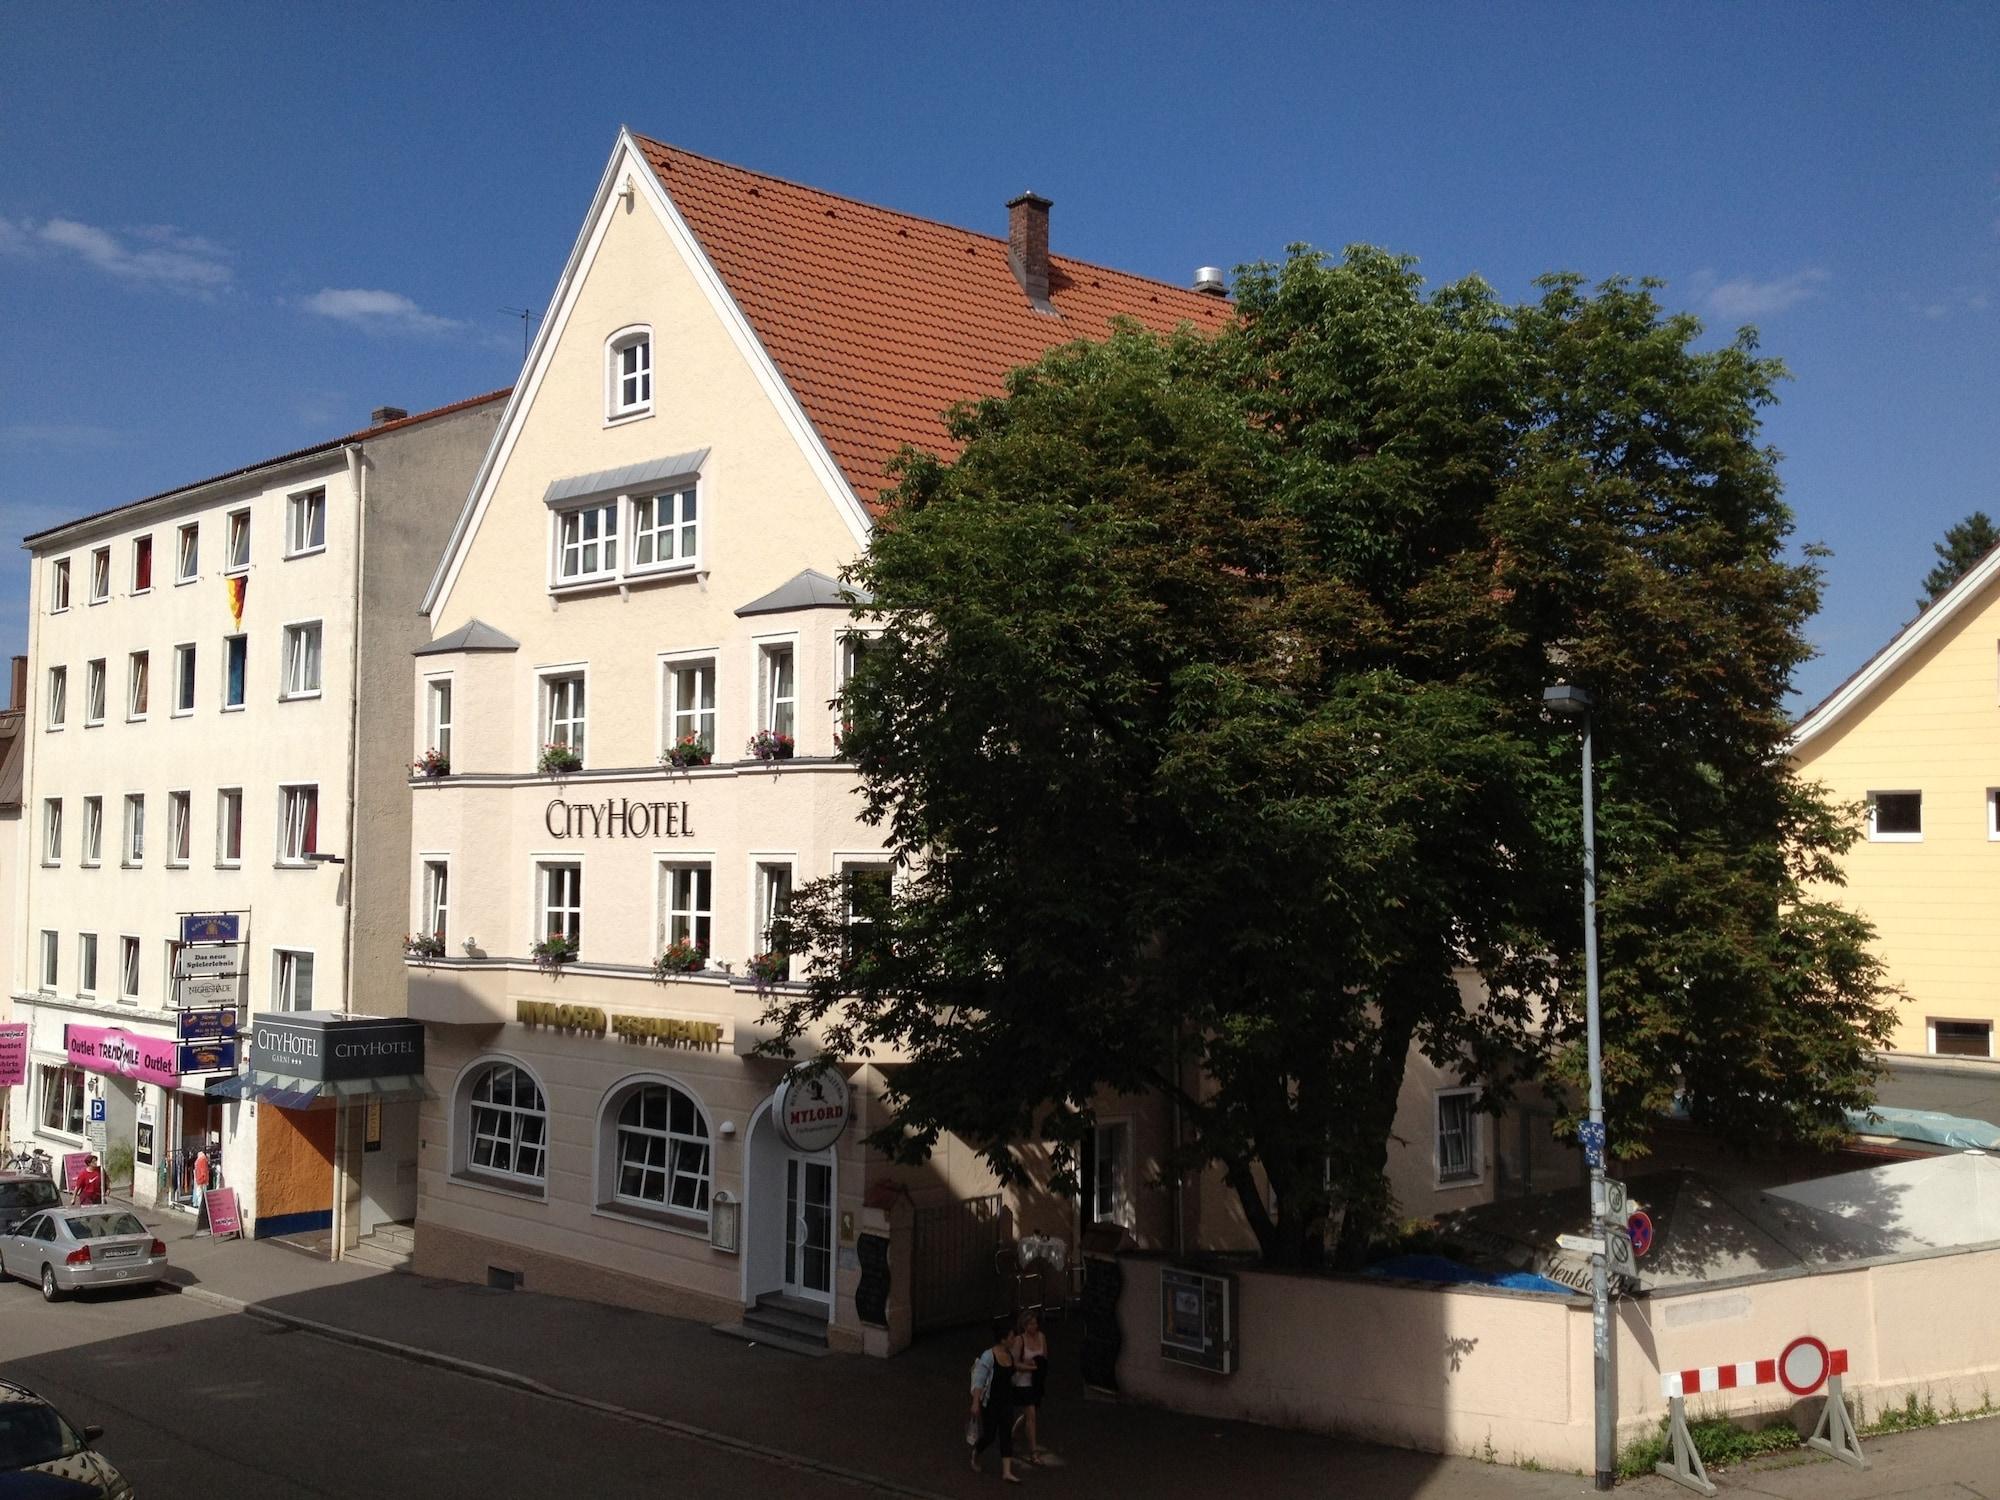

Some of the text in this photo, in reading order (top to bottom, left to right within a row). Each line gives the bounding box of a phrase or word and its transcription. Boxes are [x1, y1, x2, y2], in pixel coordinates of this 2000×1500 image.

[546, 798, 695, 839] CITYHOTEL
[517, 1000, 607, 1038] MYLORD
[257, 1029, 319, 1057] CITYHOTEL
[335, 1041, 414, 1058] CITYHOTEL
[71, 1039, 95, 1056] Outlet
[144, 1055, 172, 1073] Outlet
[272, 1054, 290, 1064] GARNI
[94, 1102, 102, 1118] P
[790, 1106, 843, 1125] MYLORD
